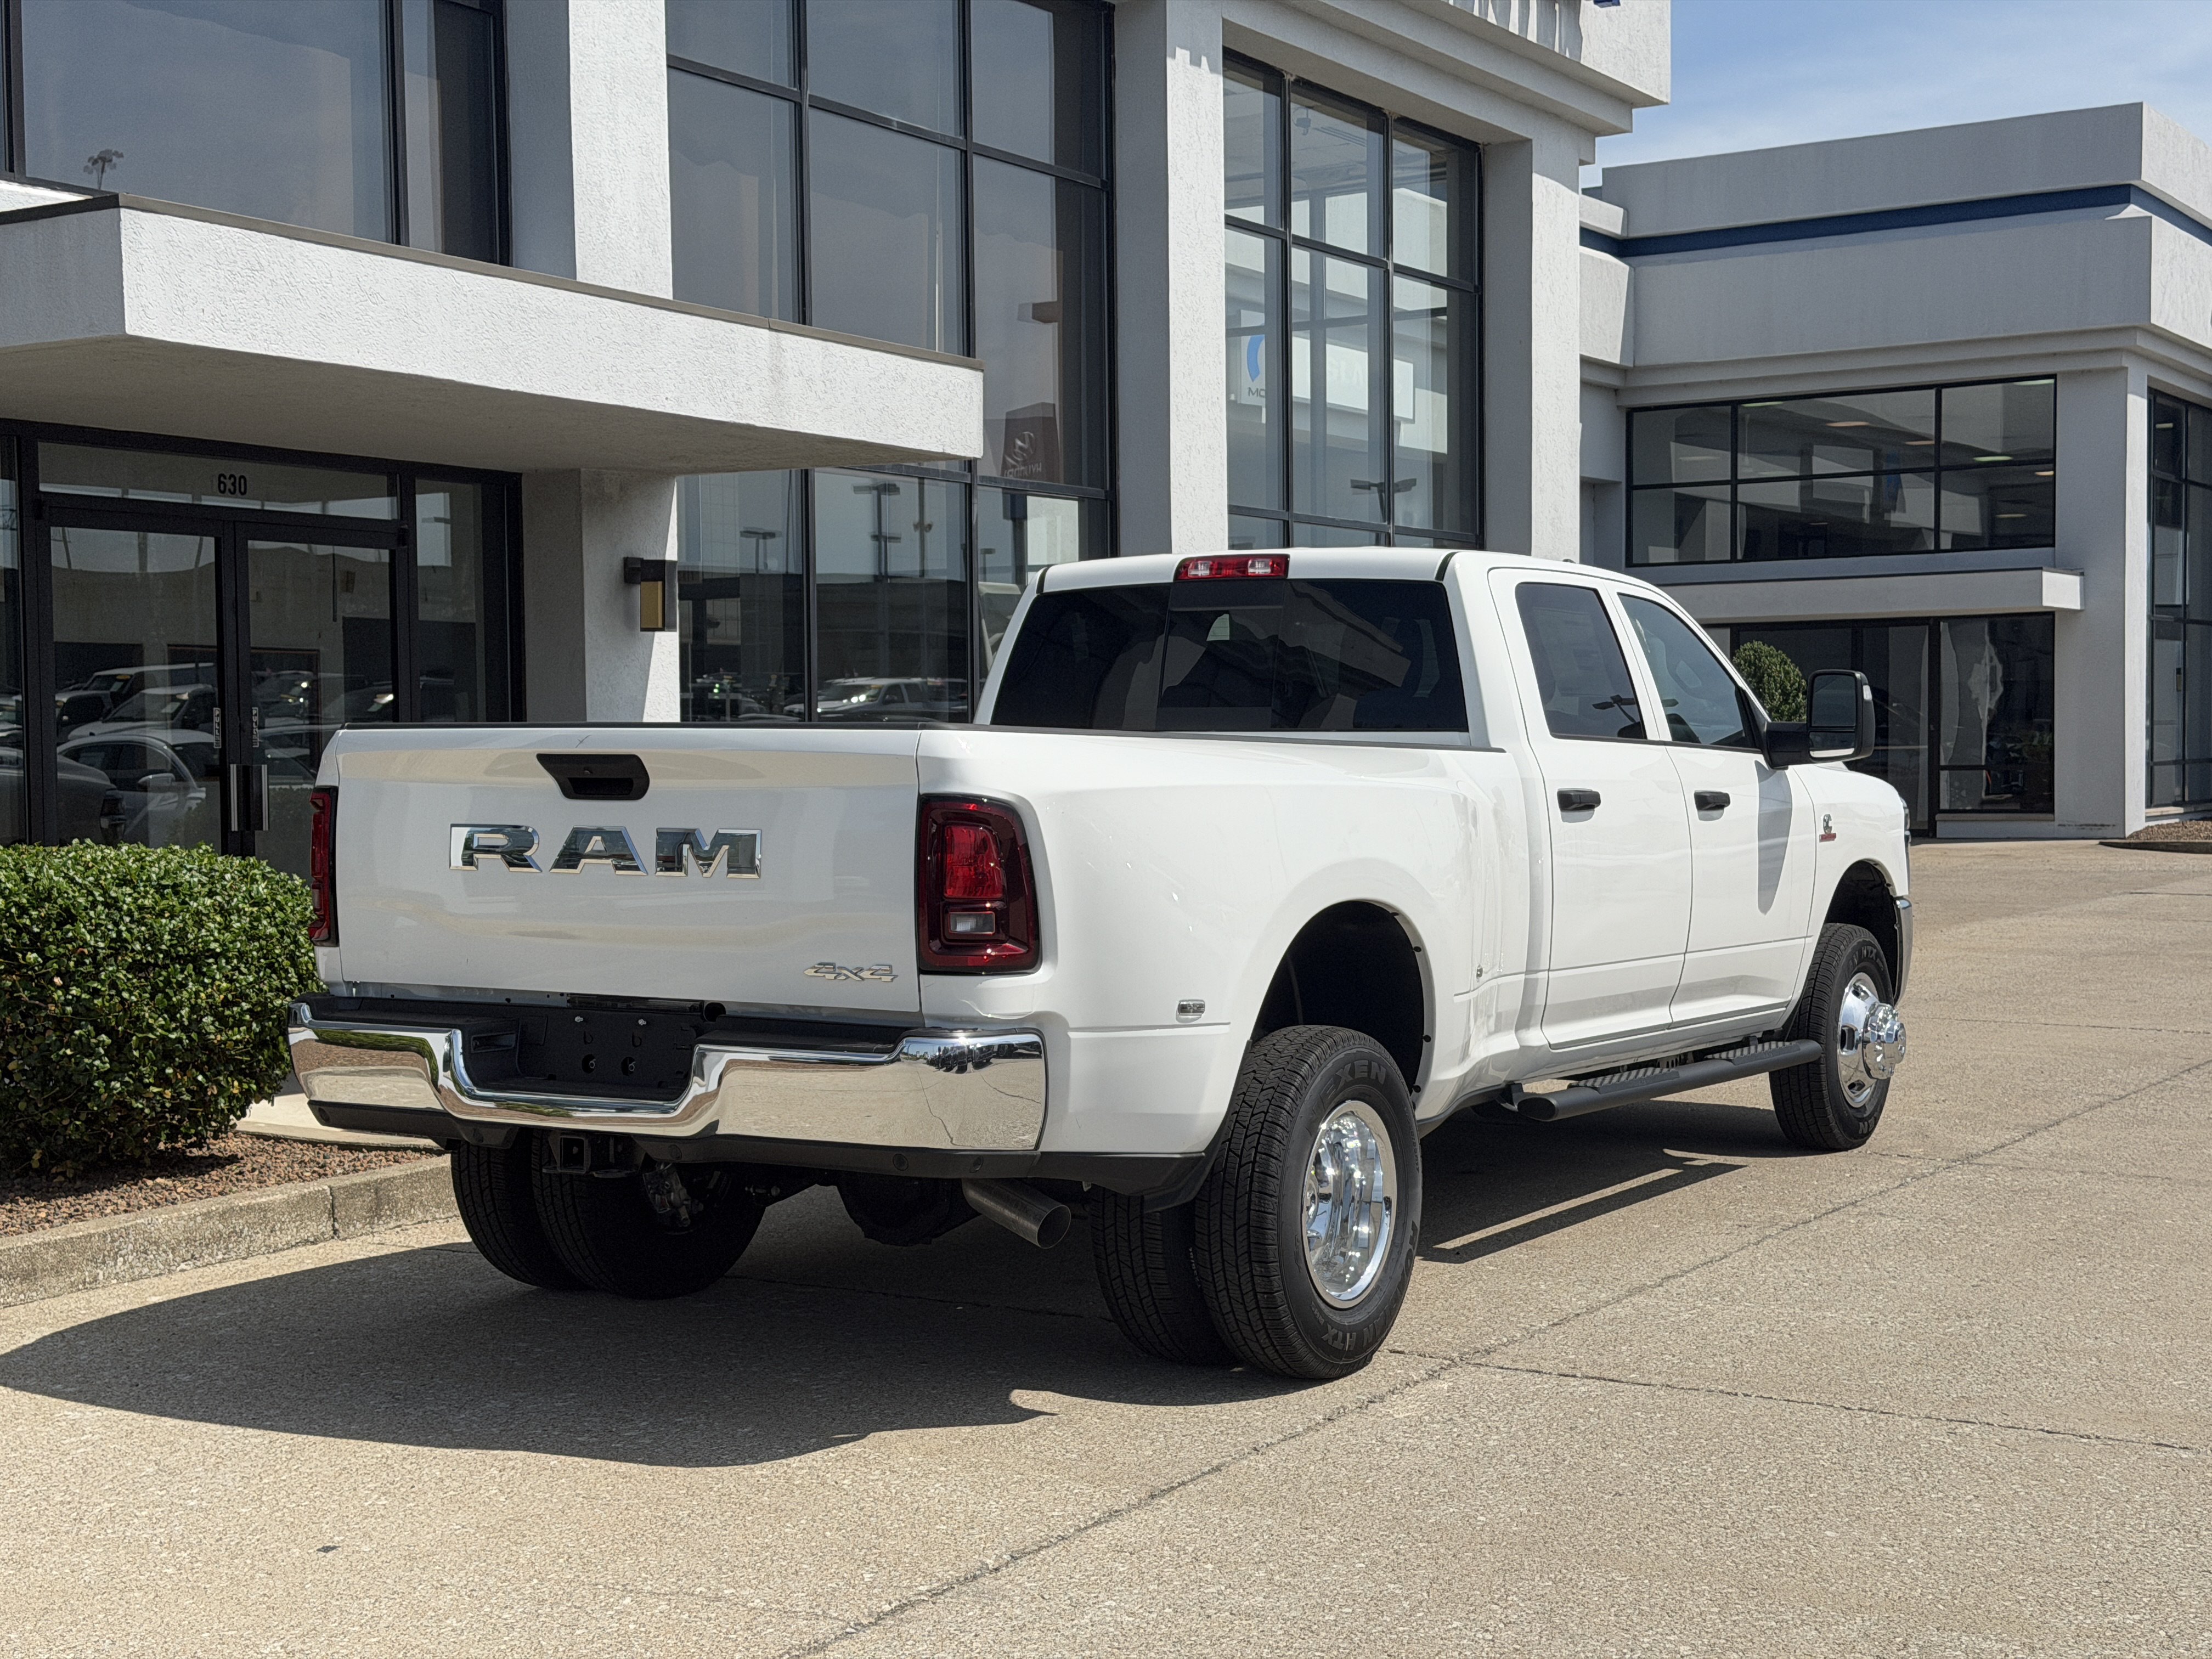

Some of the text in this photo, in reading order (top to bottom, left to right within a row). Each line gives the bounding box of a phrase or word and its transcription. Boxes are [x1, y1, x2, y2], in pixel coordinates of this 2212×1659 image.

[218, 473, 247, 495] 630
[449, 823, 762, 879] RAM
[1307, 1060, 1386, 1137] NEXEN
[1321, 1323, 1357, 1351] HTX
